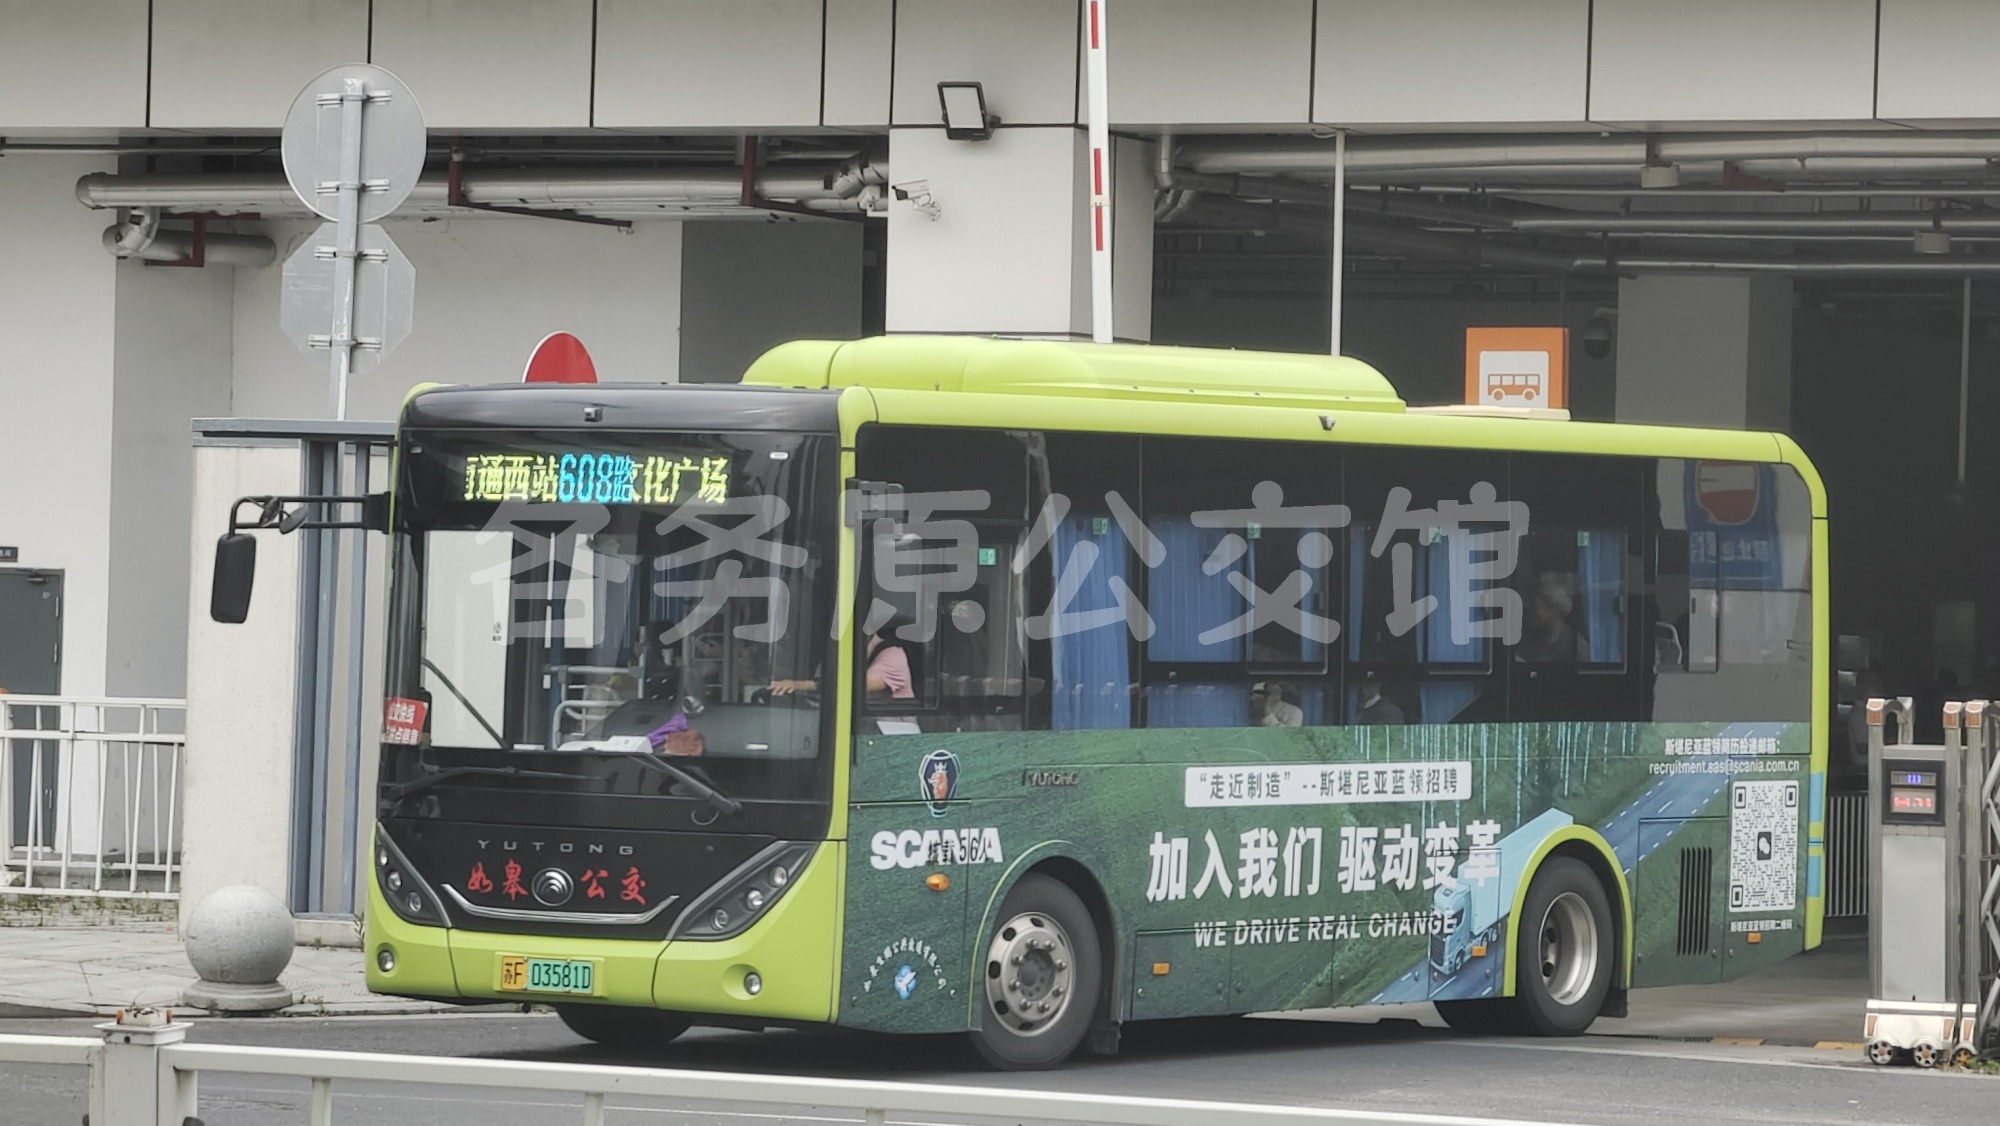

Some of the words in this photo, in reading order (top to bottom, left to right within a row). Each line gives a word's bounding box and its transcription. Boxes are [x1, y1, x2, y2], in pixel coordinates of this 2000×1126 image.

[631, 456, 730, 503] 化广场
[477, 839, 634, 856] YUTONG
[870, 827, 1003, 871] SCANIA
[1146, 826, 1322, 903] 加入我们
[1336, 819, 1502, 895] 驱动变革
[467, 858, 528, 901] 如皋
[580, 866, 647, 906] 公交
[1194, 920, 1227, 948] WE
[1234, 916, 1300, 946] DRIVE
[1307, 913, 1362, 942] REAL
[1367, 909, 1458, 939] CHANGE
